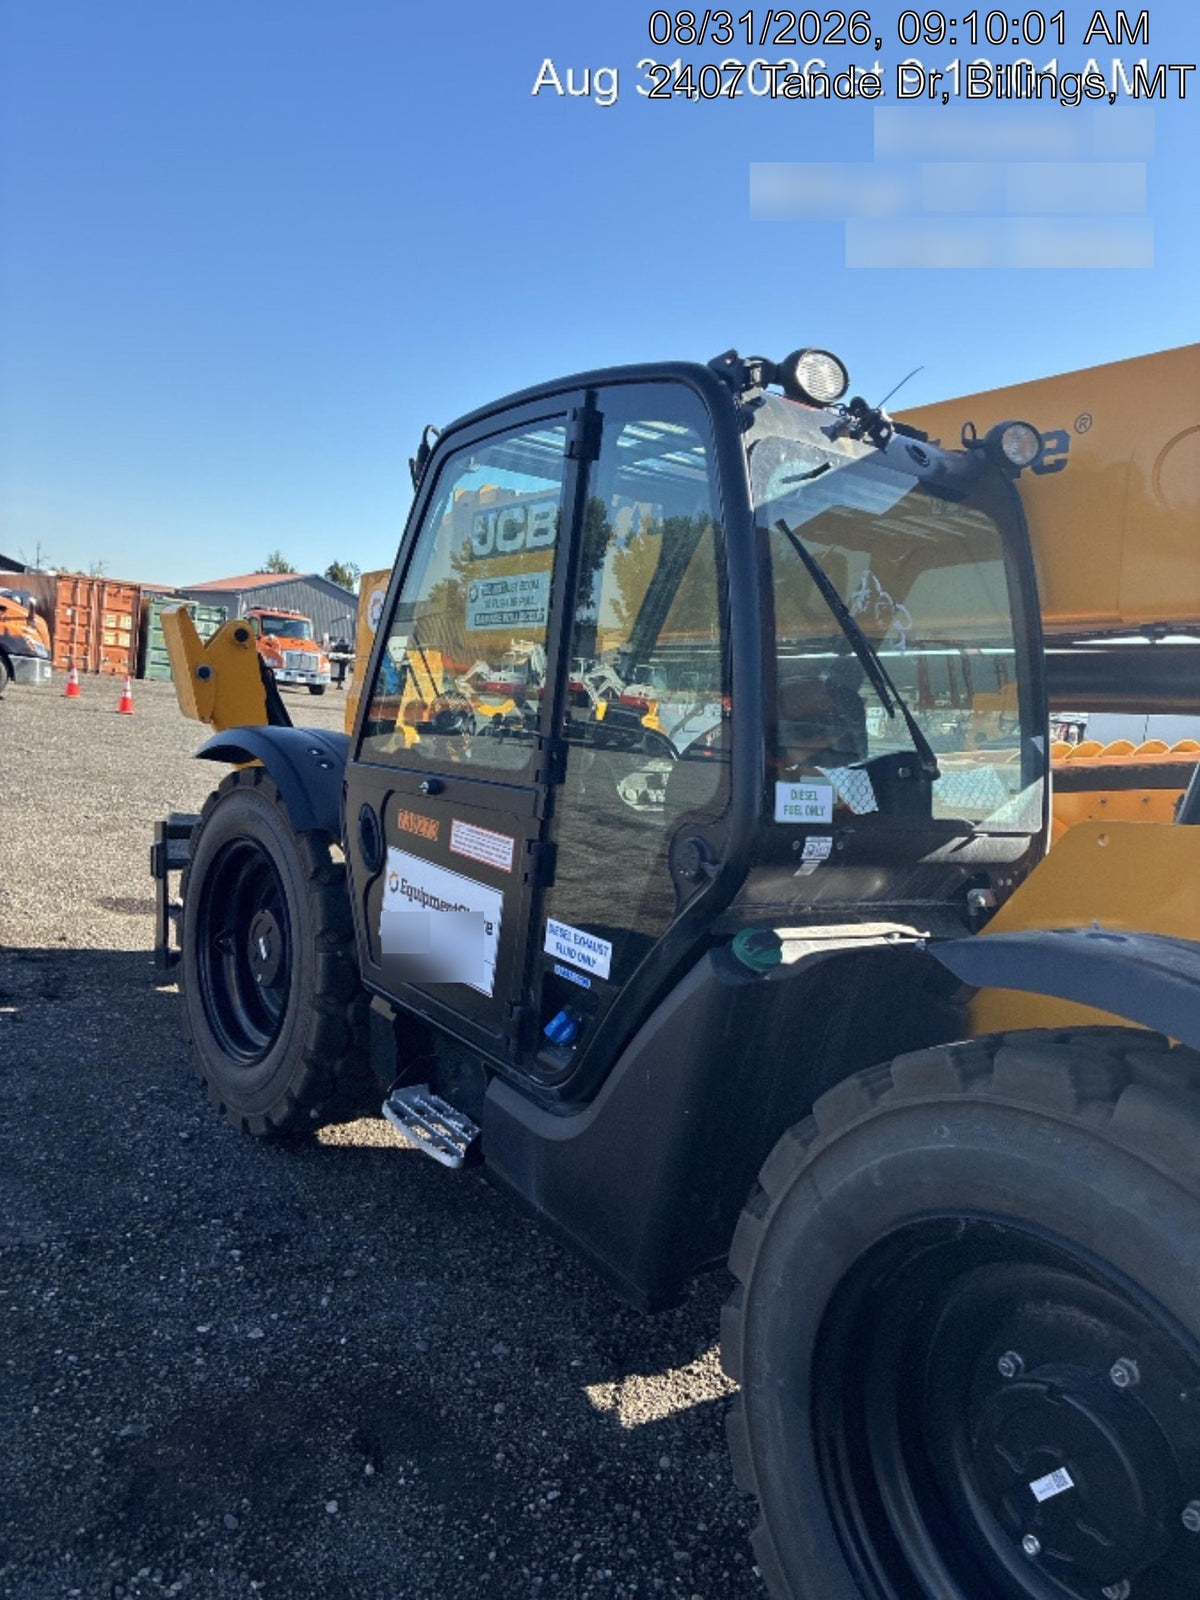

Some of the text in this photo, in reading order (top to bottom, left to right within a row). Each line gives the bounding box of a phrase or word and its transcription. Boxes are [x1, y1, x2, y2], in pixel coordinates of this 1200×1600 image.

[472, 502, 558, 556] JCB
[791, 789, 818, 801] DIESEL
[783, 804, 825, 817] FUEL ONLY
[548, 922, 610, 957] DIESEL EXHAUST
